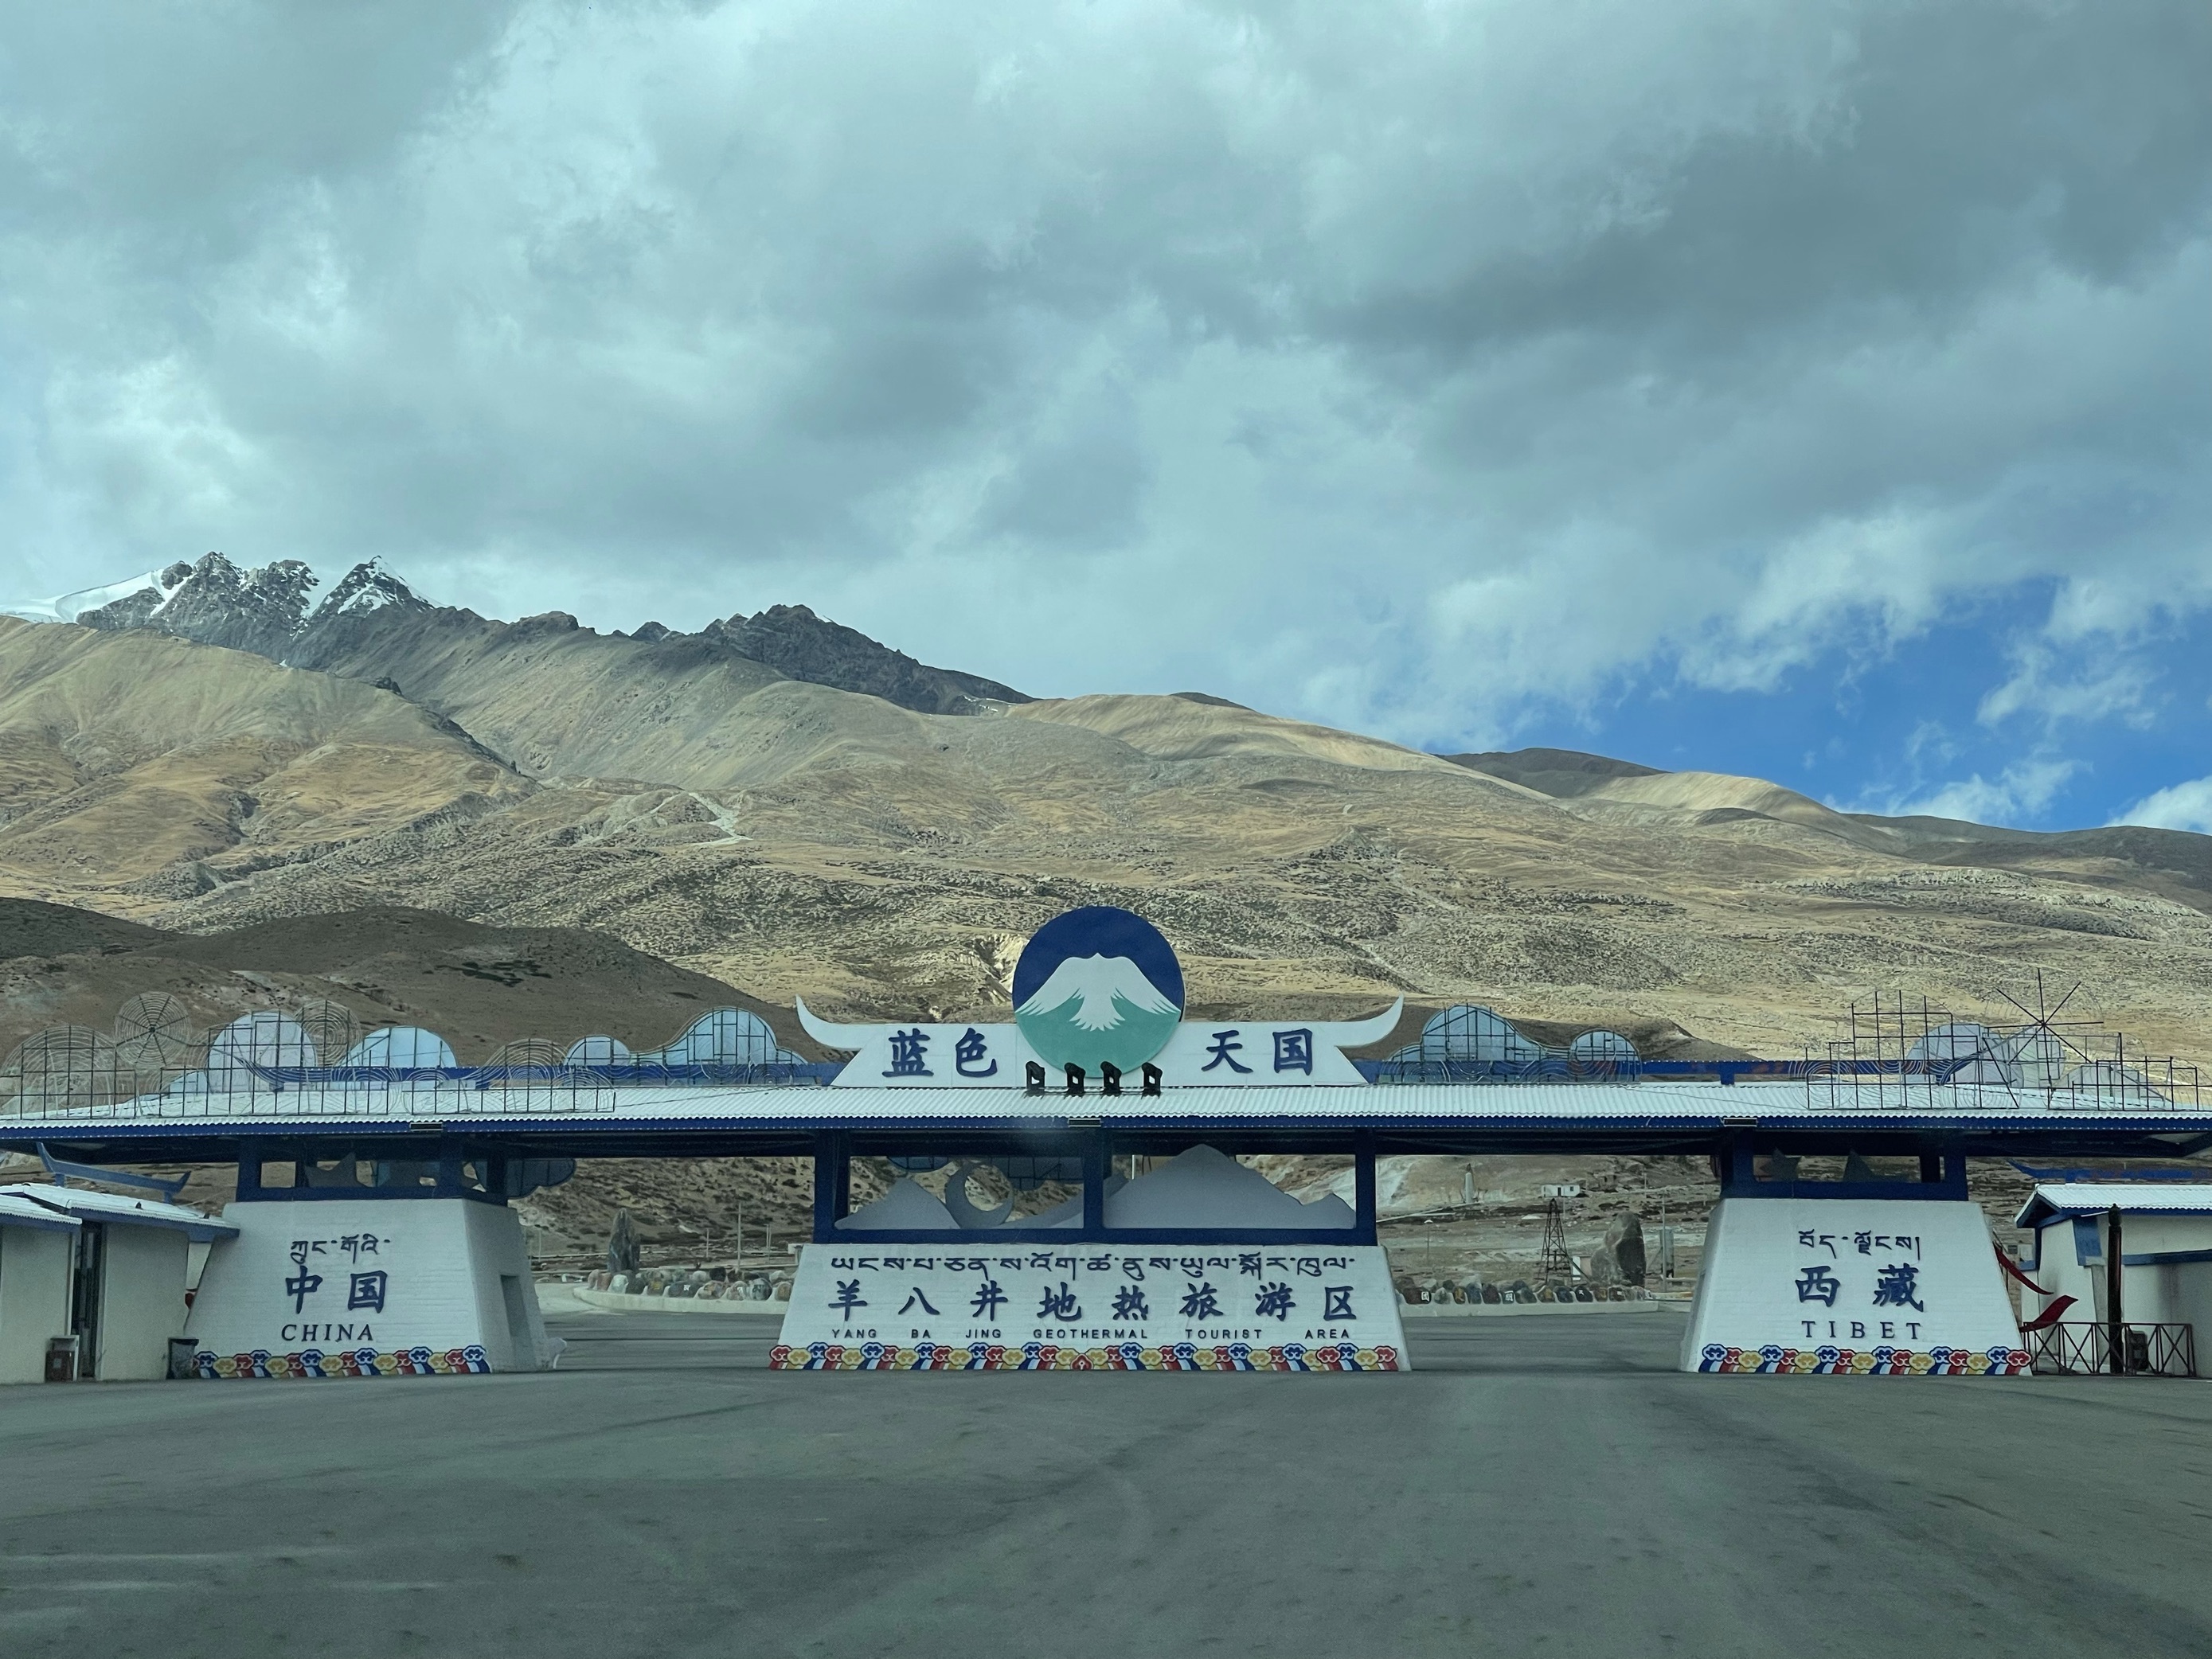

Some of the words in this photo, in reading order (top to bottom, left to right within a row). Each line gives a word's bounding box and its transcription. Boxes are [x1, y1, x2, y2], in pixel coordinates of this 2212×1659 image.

[881, 1027, 998, 1079] 蓝色
[1201, 1028, 1313, 1076] 天国
[284, 1265, 389, 1315] 中国
[827, 1278, 1357, 1322] 羊八井地热旅游区
[1794, 1262, 1925, 1313] 西藏
[281, 1323, 373, 1342] CHINA
[831, 1329, 877, 1340] YANG
[911, 1329, 932, 1340] BA
[965, 1329, 1002, 1340] JING
[1033, 1329, 1148, 1340] GEOTHERMAL
[1185, 1329, 1263, 1340] TOURIST
[1304, 1329, 1350, 1340] AREA
[1801, 1320, 1921, 1340] TIBET
